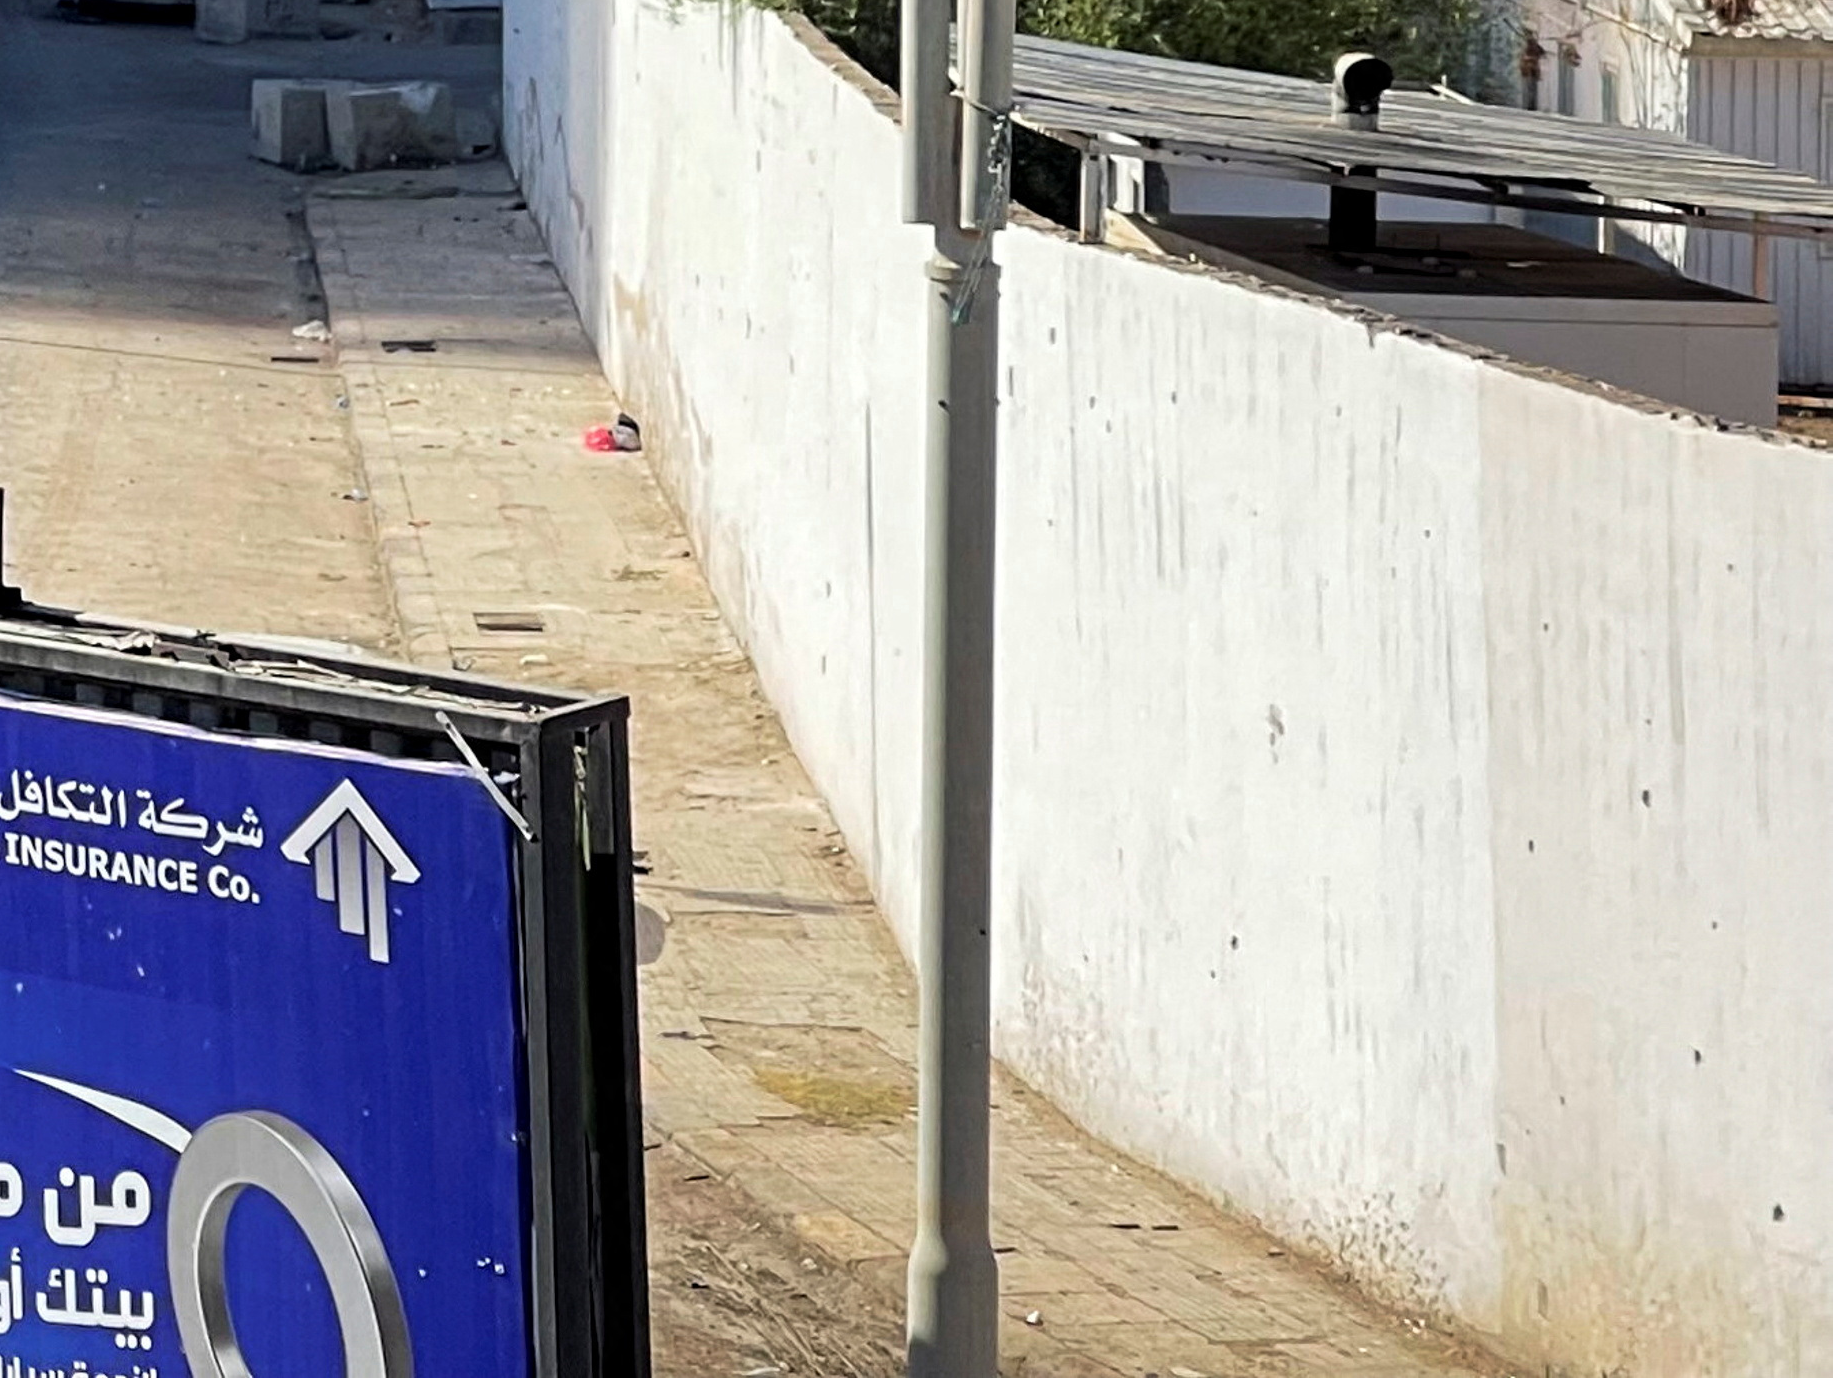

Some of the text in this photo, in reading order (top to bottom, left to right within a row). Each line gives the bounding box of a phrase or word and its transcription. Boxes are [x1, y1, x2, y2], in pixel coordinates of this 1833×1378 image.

[136, 786, 265, 856] شركة
[4, 831, 199, 894] INSURANCE
[207, 864, 262, 905] Co.
[42, 1166, 152, 1247] من
[35, 1267, 155, 1351] بيتك
